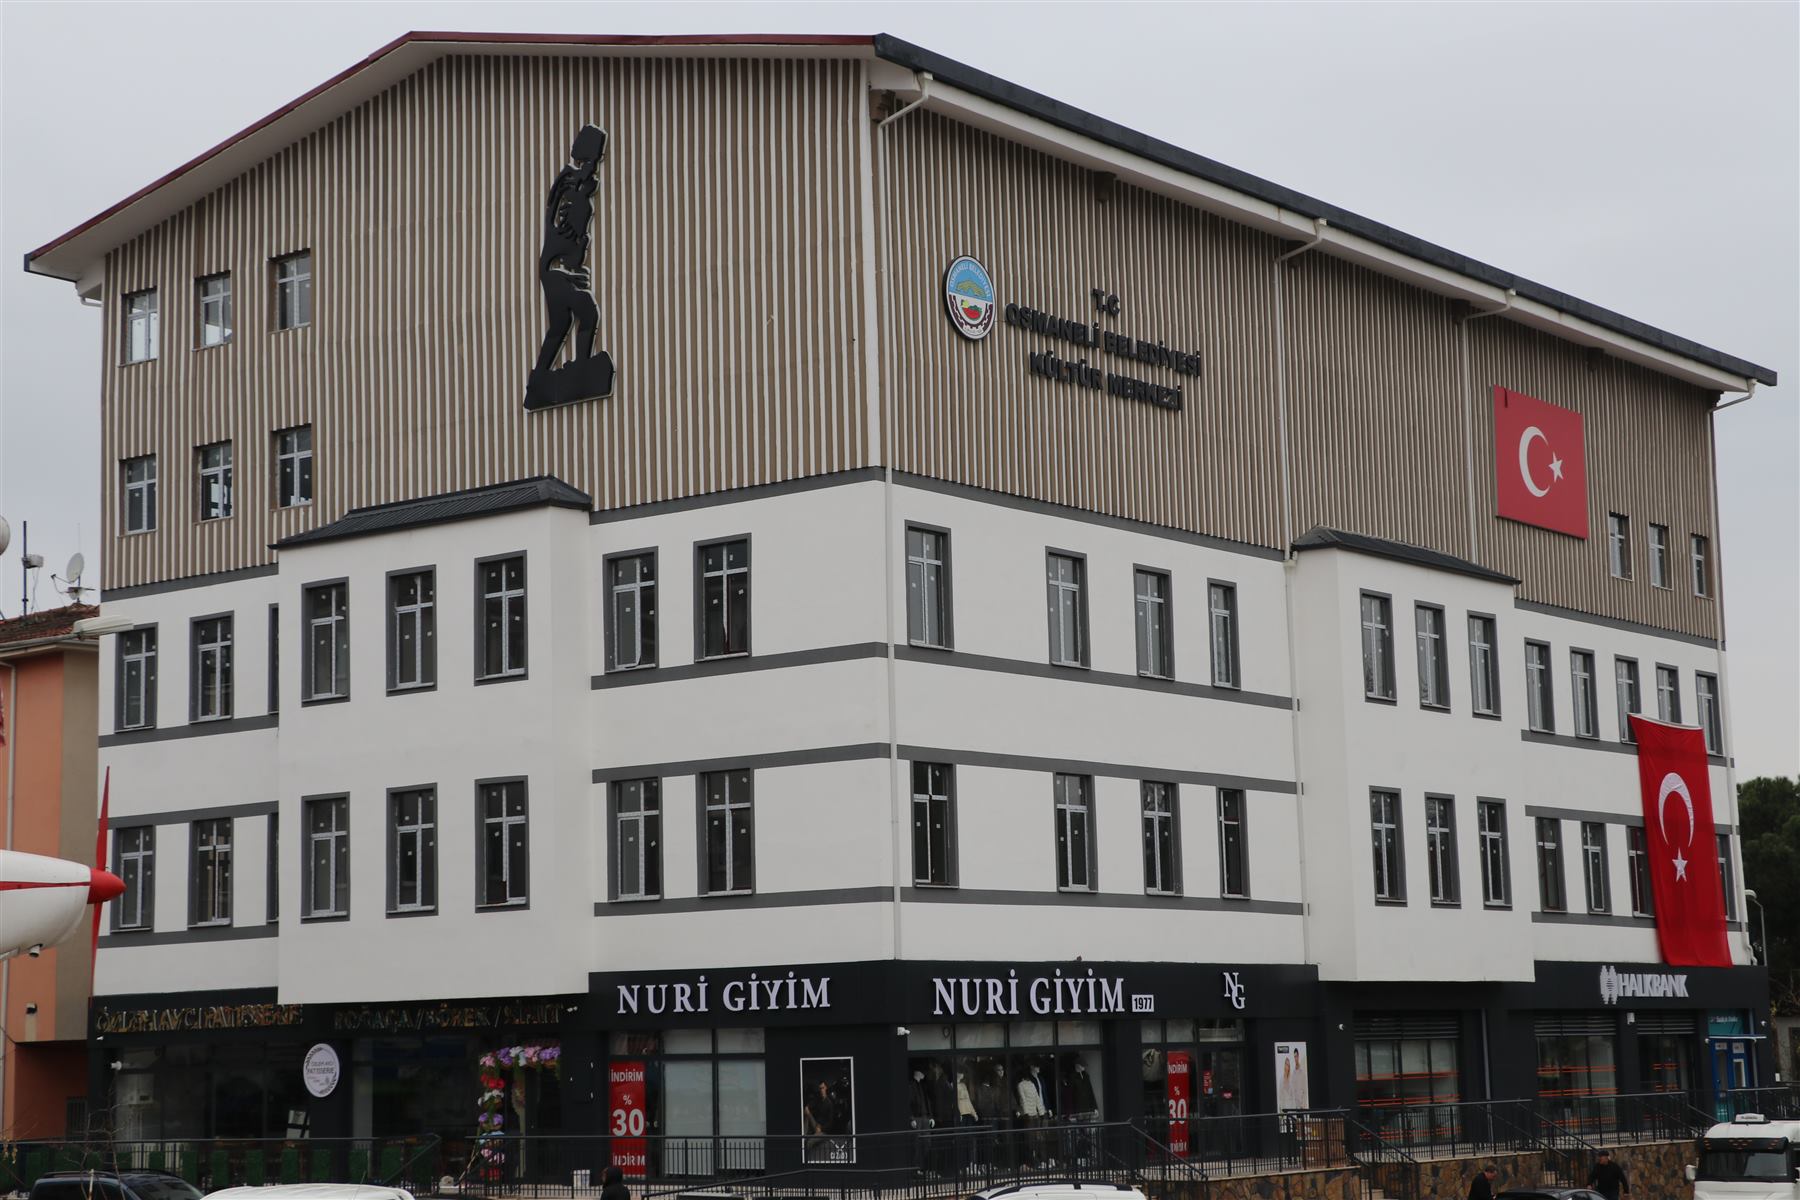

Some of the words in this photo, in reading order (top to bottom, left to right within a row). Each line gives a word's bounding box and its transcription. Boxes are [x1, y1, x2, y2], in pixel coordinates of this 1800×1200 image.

[1005, 302, 1101, 350] OSMANELİ
[1103, 329, 1200, 378] BELEDİYESİ
[1029, 350, 1103, 391] KÜLTÜR
[1106, 372, 1183, 413] MERKEZİ
[616, 975, 709, 1015] NURİ
[722, 971, 831, 1012] GİYİM
[932, 969, 1020, 1016] NURİ
[1029, 968, 1125, 1014] GİYİM
[1133, 996, 1153, 1011] 1977
[1617, 973, 1689, 998] HALKBANK
[610, 1068, 644, 1083] İNDİRİM
[612, 1108, 645, 1137] 30
[1168, 1098, 1187, 1125] 30
